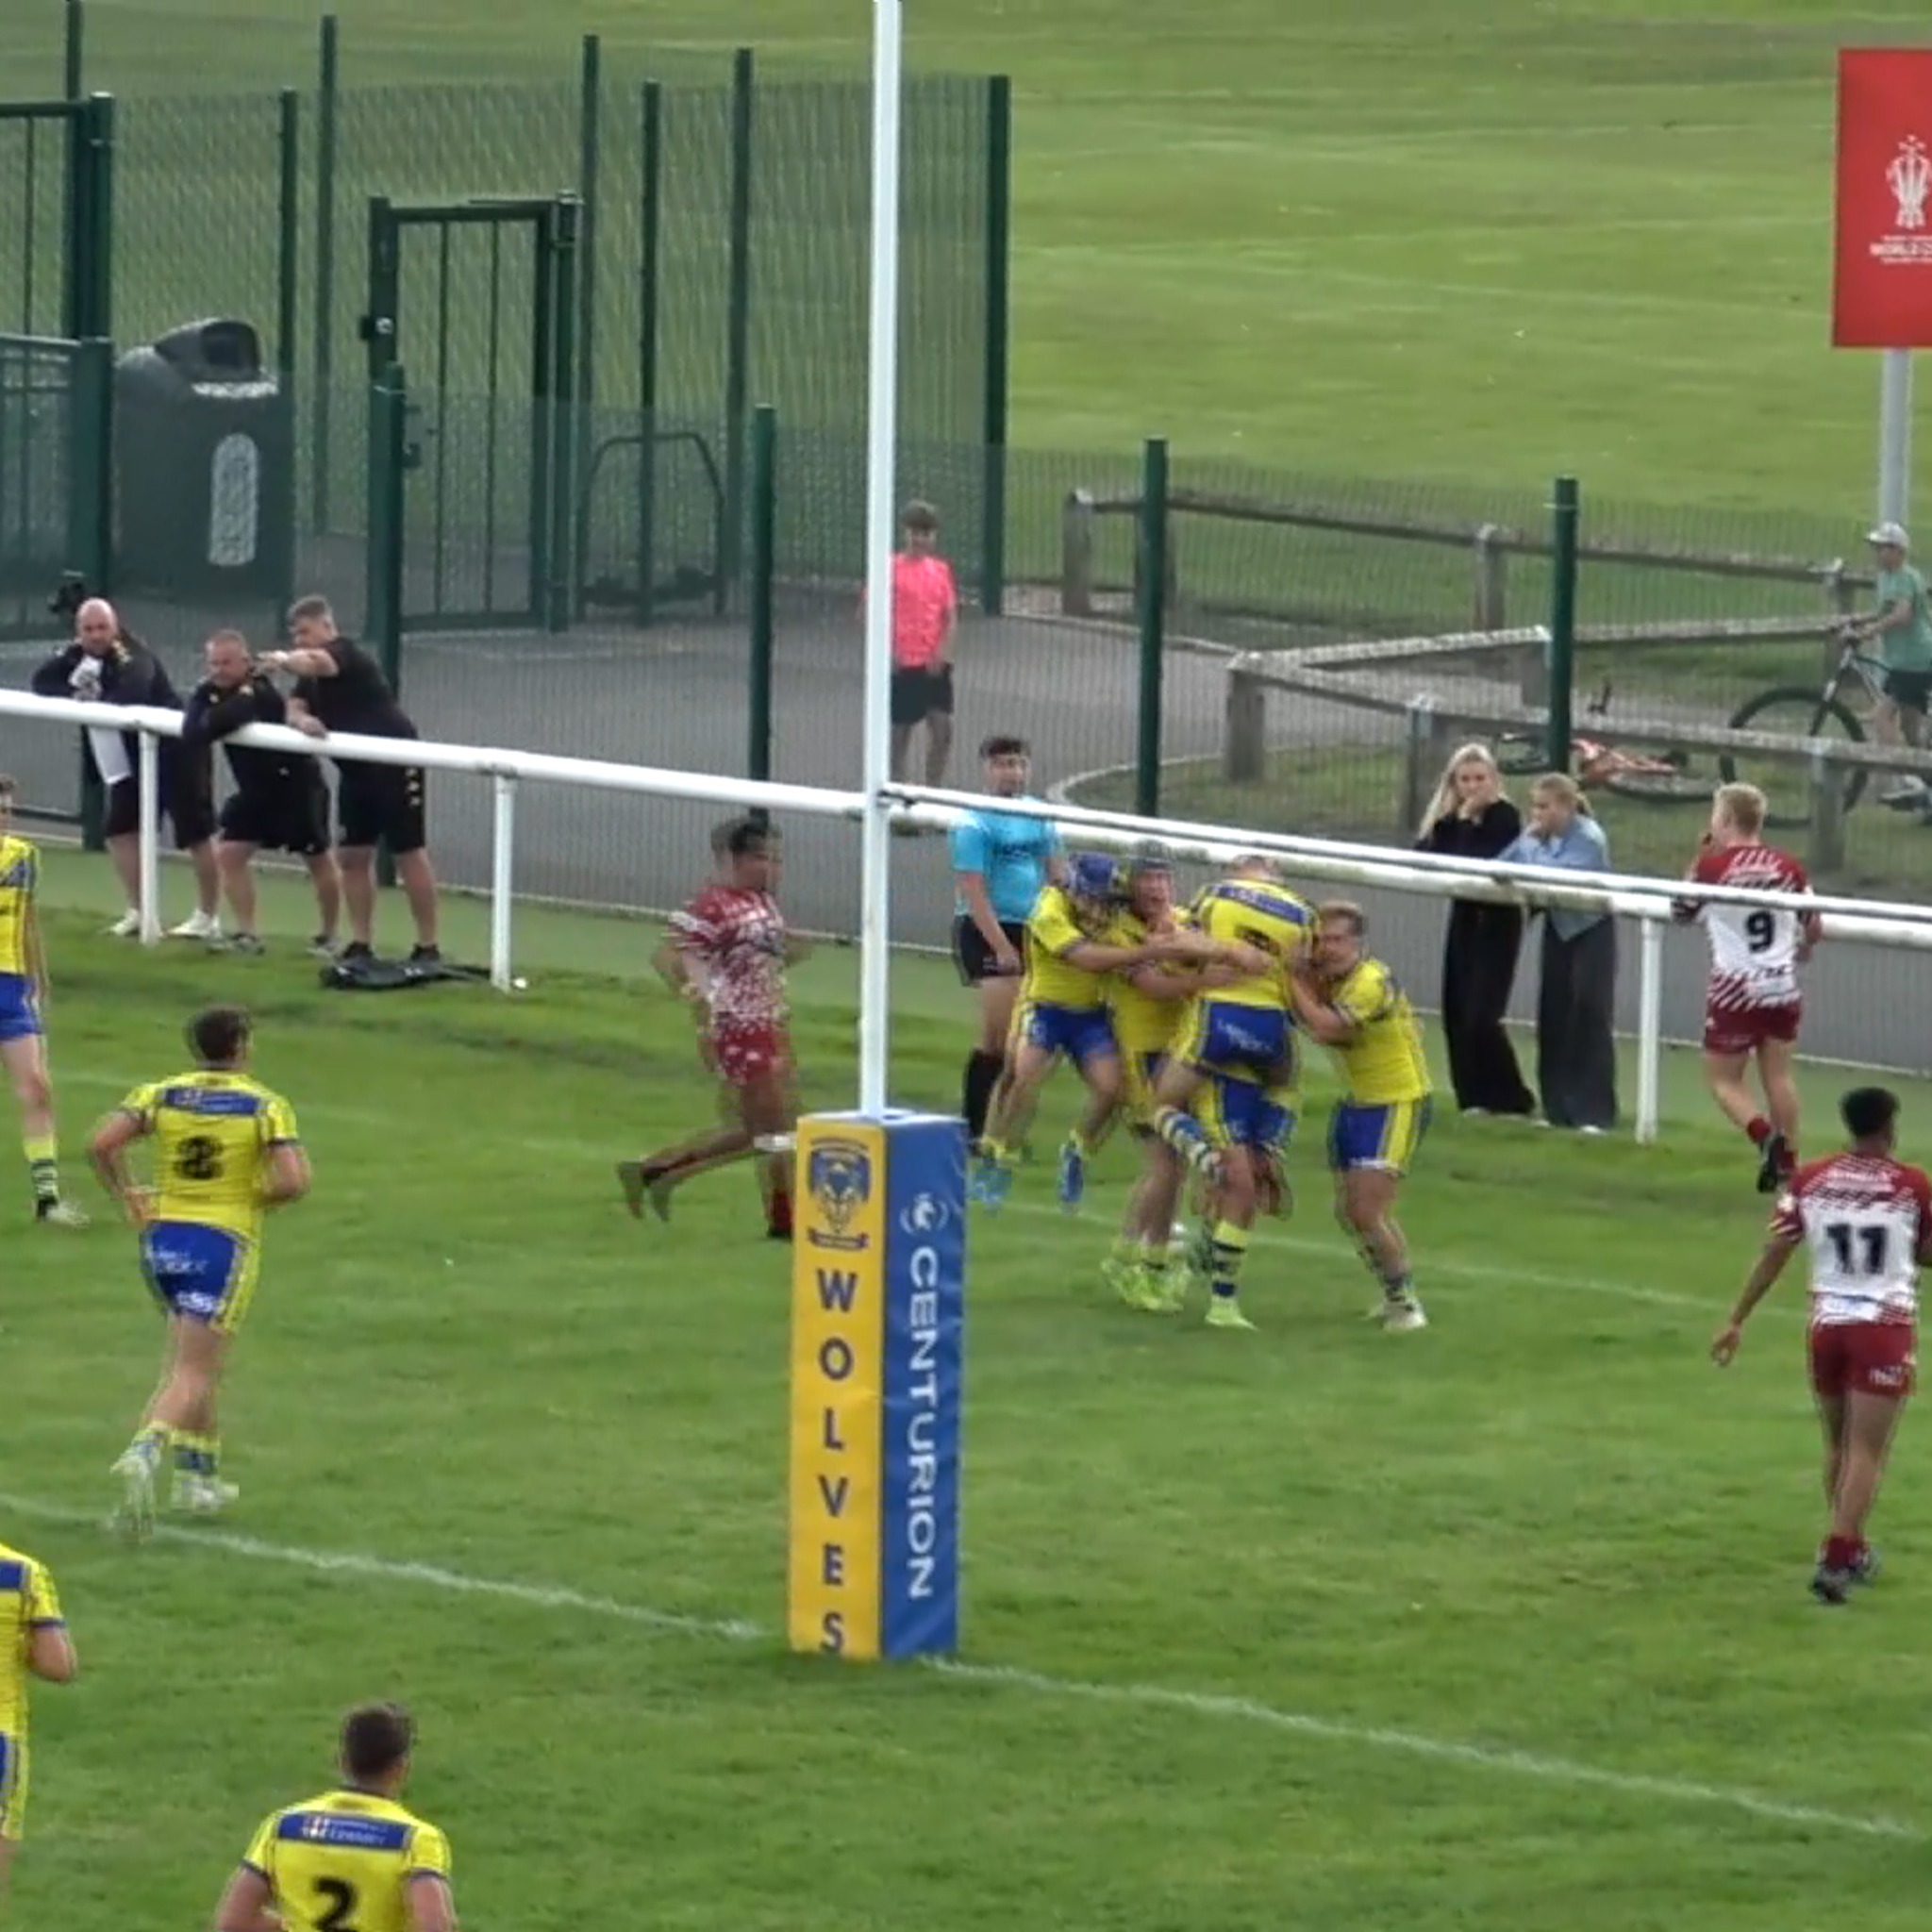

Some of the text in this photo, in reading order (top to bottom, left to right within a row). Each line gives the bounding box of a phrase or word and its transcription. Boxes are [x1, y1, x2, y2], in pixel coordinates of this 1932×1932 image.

[1747, 909, 1774, 953] 9
[1826, 1223, 1888, 1274] 11
[908, 1245, 940, 1600] CENTURION
[816, 1268, 858, 1653] WOLVES
[315, 1874, 358, 1932] 2
